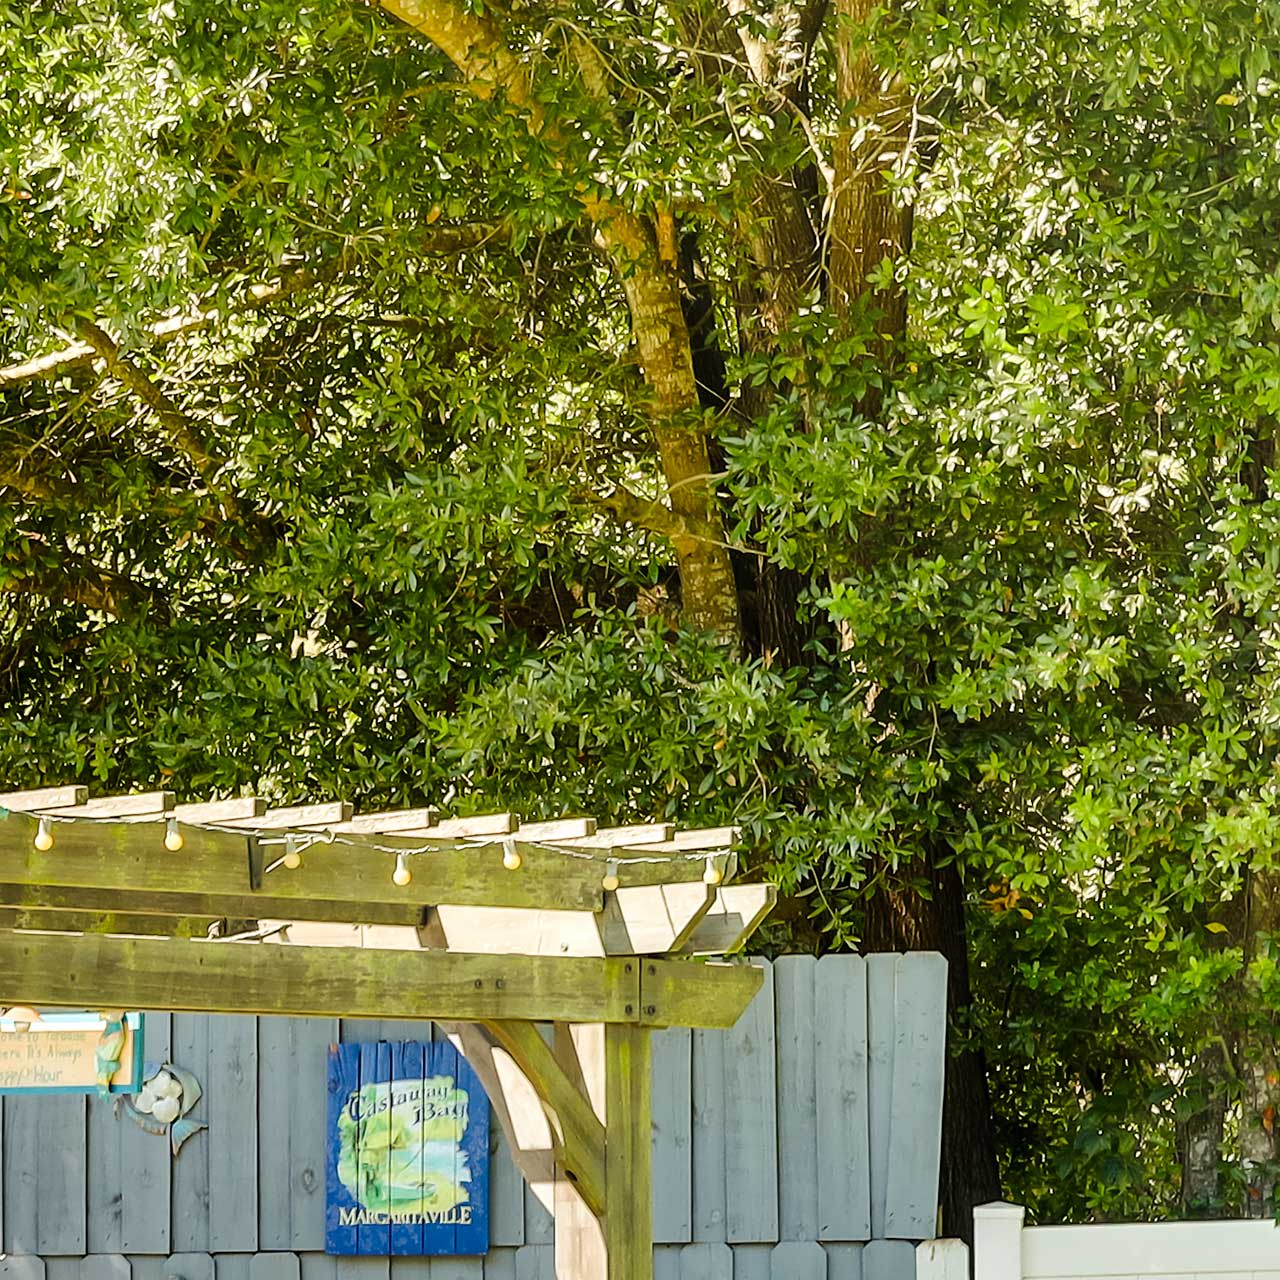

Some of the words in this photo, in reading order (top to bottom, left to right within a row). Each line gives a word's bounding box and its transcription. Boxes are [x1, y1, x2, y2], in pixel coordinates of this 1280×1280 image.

[47, 1045, 82, 1064] Always
[32, 1064, 63, 1083] Hour
[346, 1086, 450, 1121] Castaway
[412, 1102, 467, 1125] Bay
[338, 1206, 473, 1226] MARGARITAVILLE
